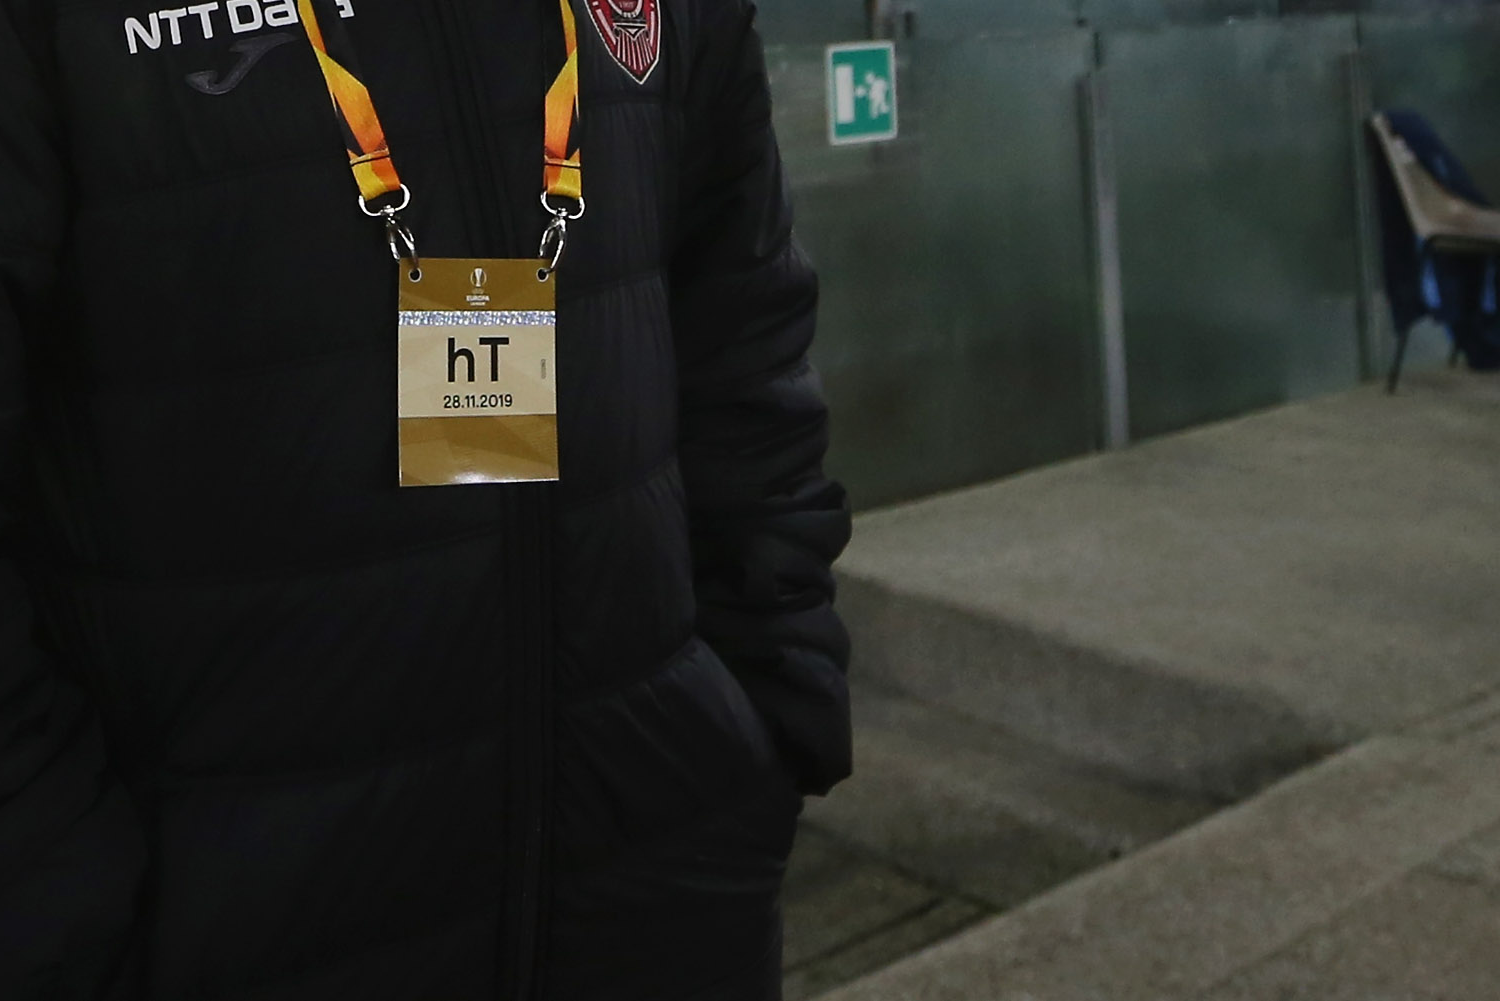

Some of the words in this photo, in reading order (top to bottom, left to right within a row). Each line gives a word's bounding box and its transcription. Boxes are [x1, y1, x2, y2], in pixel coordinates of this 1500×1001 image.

[124, 2, 219, 54] NTT
[448, 337, 509, 382] hT
[443, 394, 513, 409] 28.11.2019
